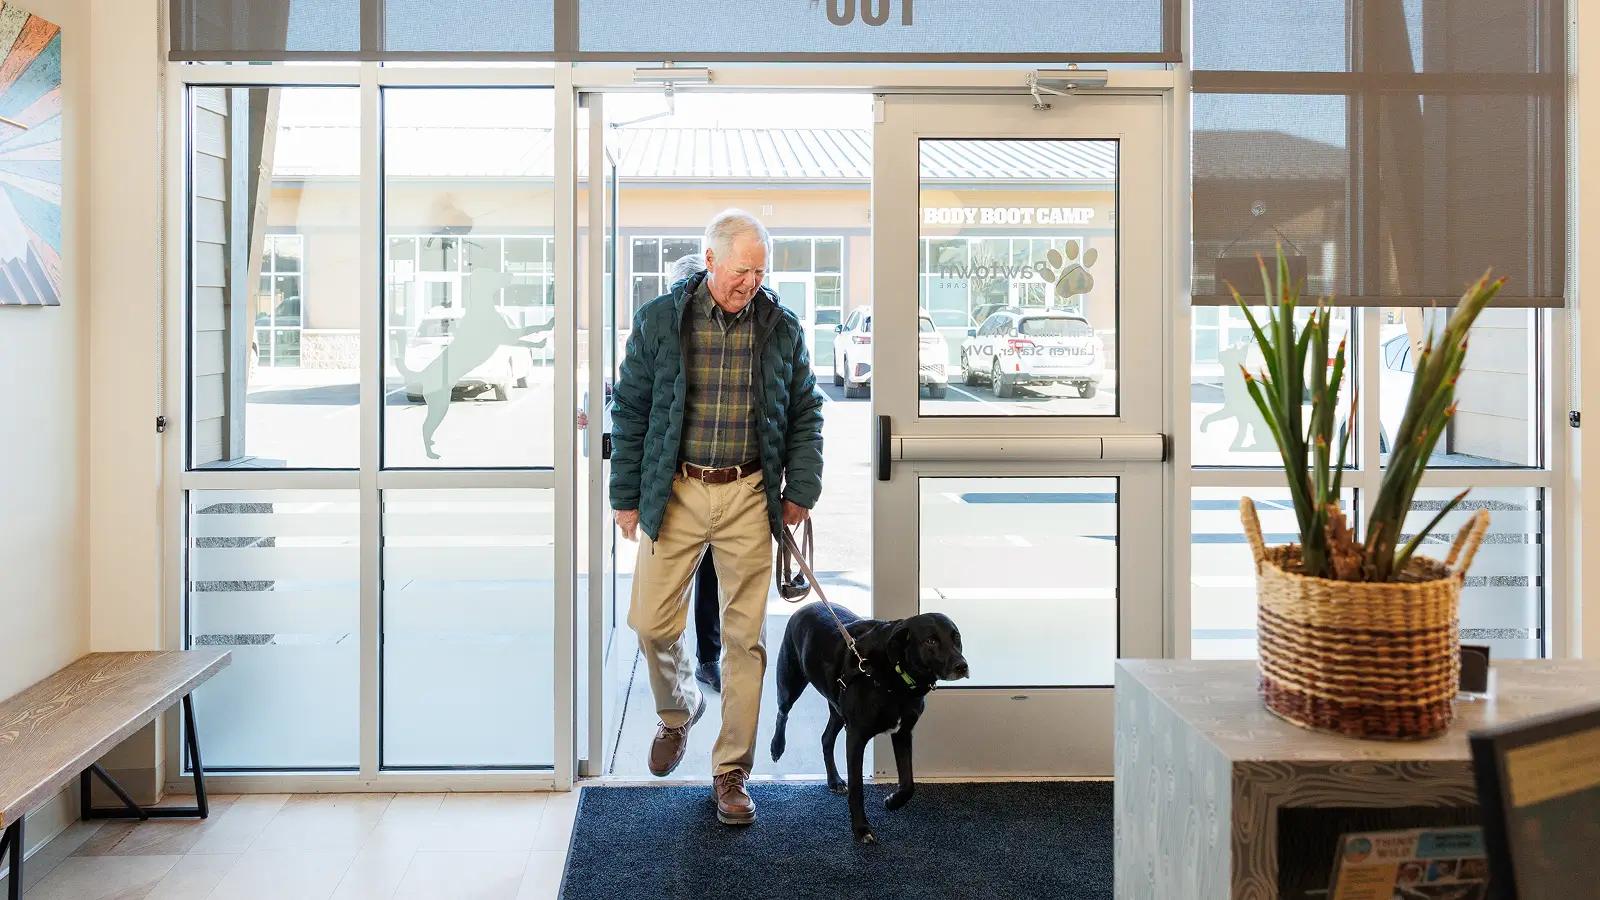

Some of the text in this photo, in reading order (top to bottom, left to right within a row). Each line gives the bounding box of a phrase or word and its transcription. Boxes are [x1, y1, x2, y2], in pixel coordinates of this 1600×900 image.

[923, 207, 1095, 225] BODY BOOT CAMP
